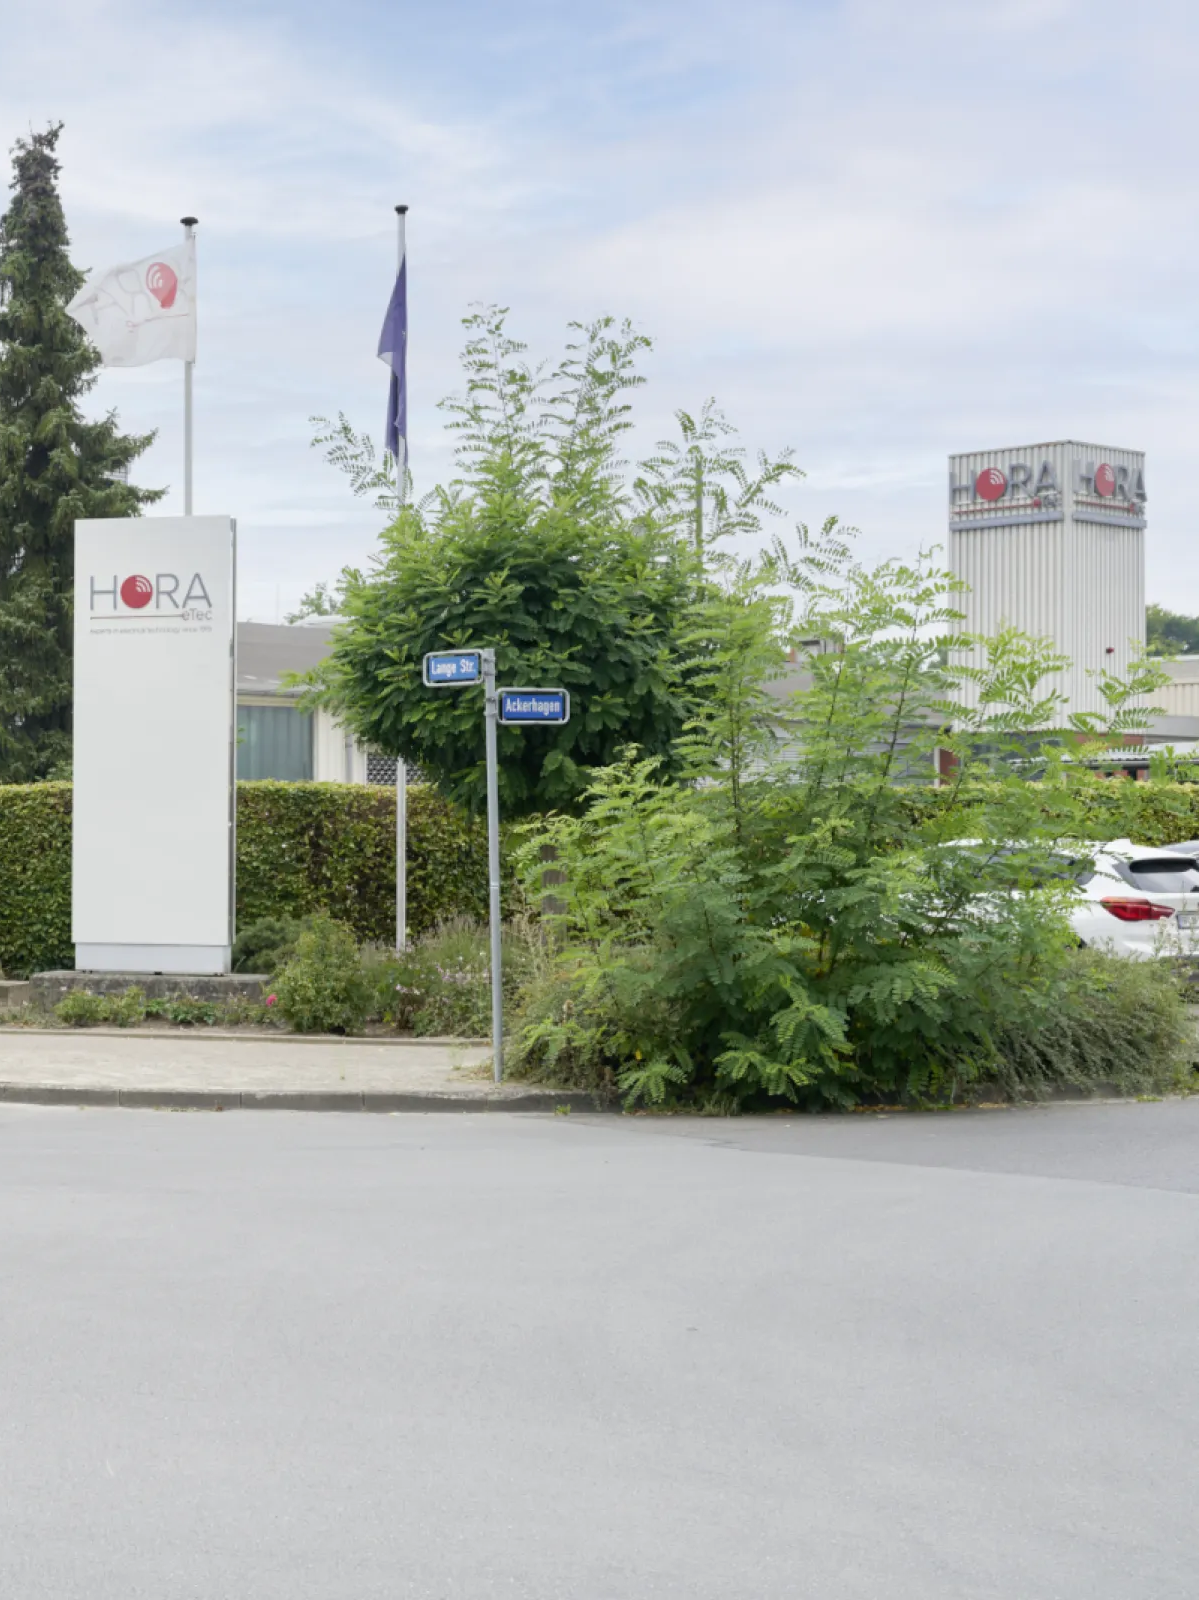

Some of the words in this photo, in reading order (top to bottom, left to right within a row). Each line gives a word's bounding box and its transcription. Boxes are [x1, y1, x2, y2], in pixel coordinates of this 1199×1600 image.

[949, 460, 1060, 504] HORA
[1073, 459, 1147, 503] HORA
[90, 572, 213, 611] HORA
[182, 607, 213, 621] eTec
[431, 660, 457, 677] Lange
[460, 659, 475, 673] Str.
[505, 698, 560, 716] Ackerhagen
